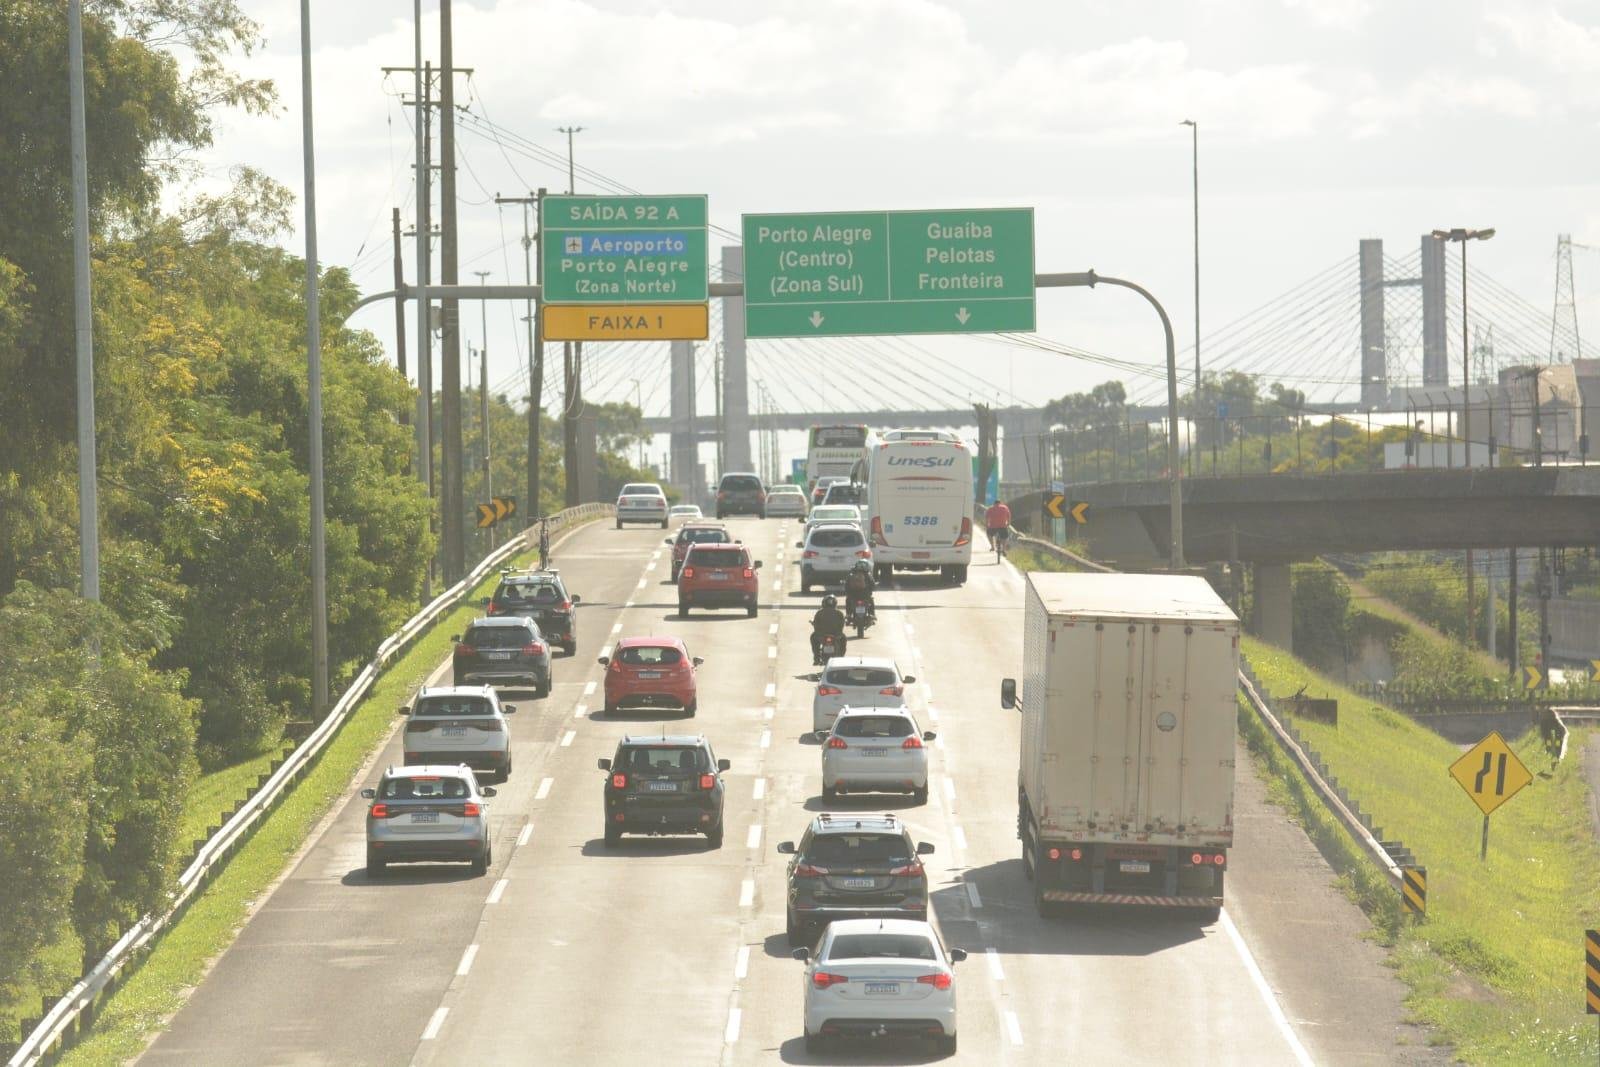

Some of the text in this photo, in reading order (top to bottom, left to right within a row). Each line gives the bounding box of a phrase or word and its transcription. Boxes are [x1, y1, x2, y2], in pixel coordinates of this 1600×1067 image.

[570, 203, 680, 221] SAÍDA 92 A
[758, 224, 873, 246] Porto Alegre
[927, 222, 993, 240] Guaíba
[589, 237, 684, 255] Aeroporto
[779, 249, 854, 271] (Centro)
[926, 247, 995, 264] Pelotas
[561, 259, 689, 276] Porto Alegre
[575, 279, 677, 294] (Zona Norte)
[770, 274, 864, 297] (Zona Sul)
[918, 272, 1004, 290] Fronteira
[588, 316, 664, 330] FAIXA 1
[903, 515, 939, 526] 5388
